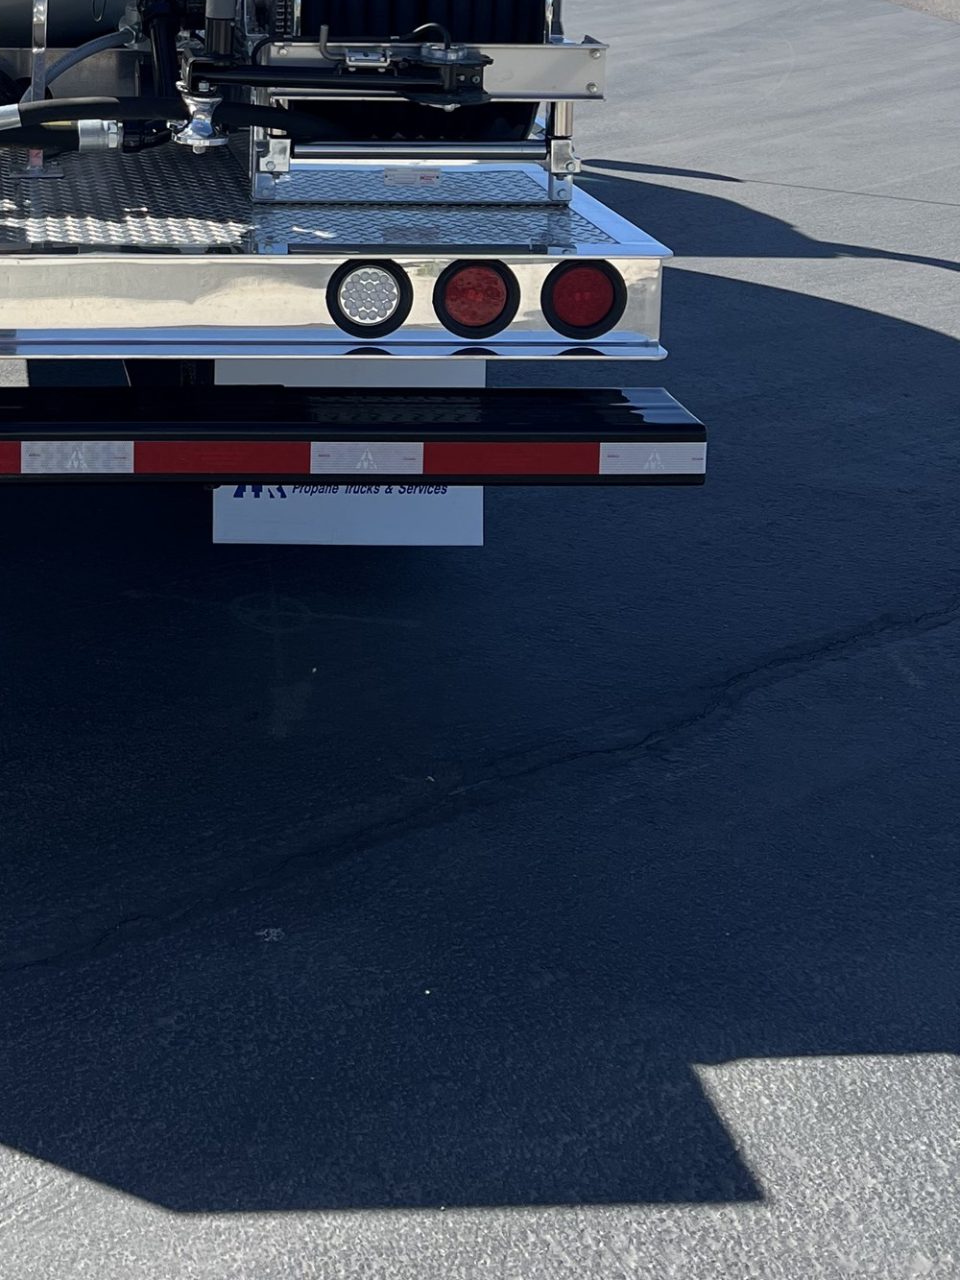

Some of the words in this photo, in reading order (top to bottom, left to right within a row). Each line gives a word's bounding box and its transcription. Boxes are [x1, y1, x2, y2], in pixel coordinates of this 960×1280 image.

[292, 485, 339, 496] Propane
[344, 485, 381, 494] Trucks
[398, 485, 448, 495] Services
